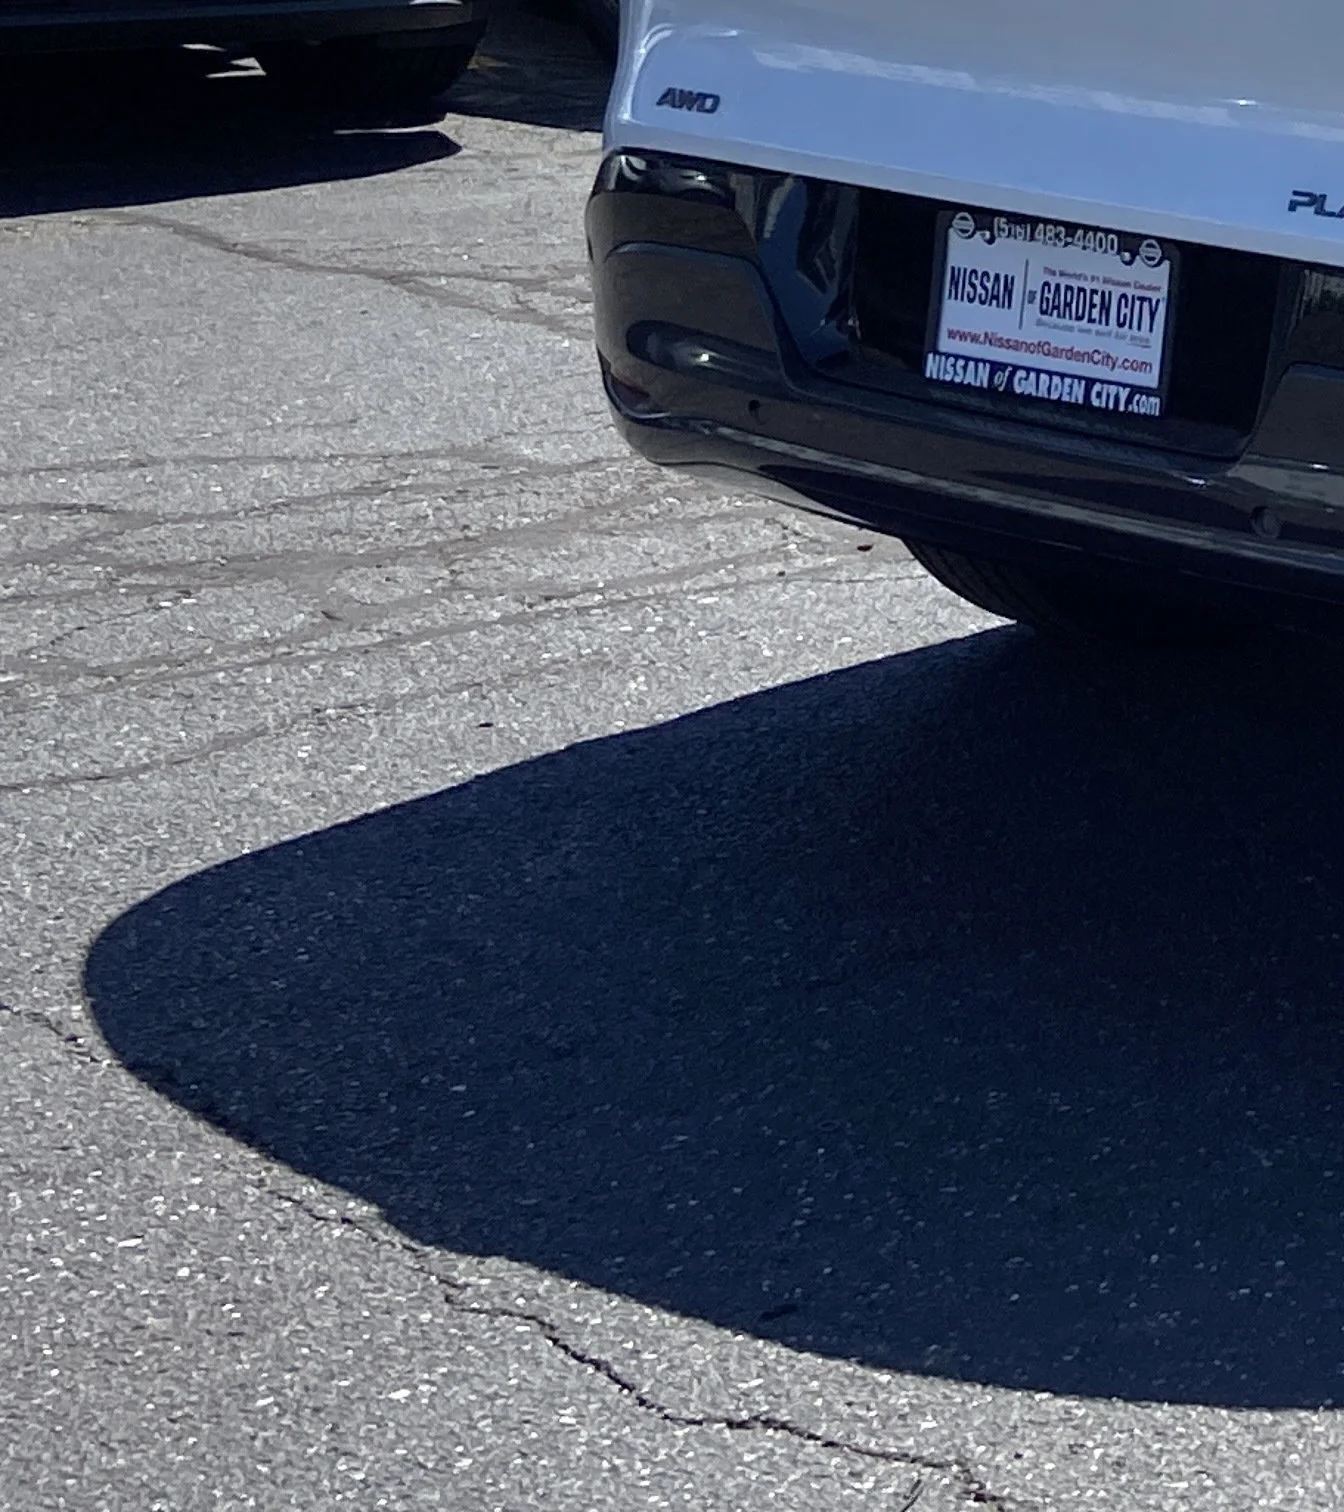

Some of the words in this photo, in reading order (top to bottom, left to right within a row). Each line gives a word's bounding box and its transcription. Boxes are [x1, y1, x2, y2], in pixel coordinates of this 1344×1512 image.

[656, 87, 720, 114] AWD
[1034, 223, 1118, 256] 483-4400
[948, 265, 1015, 310] NISSAN
[1039, 280, 1113, 327] GARDEN
[1116, 292, 1161, 334] CITY
[946, 328, 1153, 375] www.NissanofGardenCity.com
[924, 352, 991, 389] NISSAN
[993, 365, 1012, 392] of
[1013, 369, 1084, 405] GARDEN
[1090, 383, 1161, 417] CITY.com
